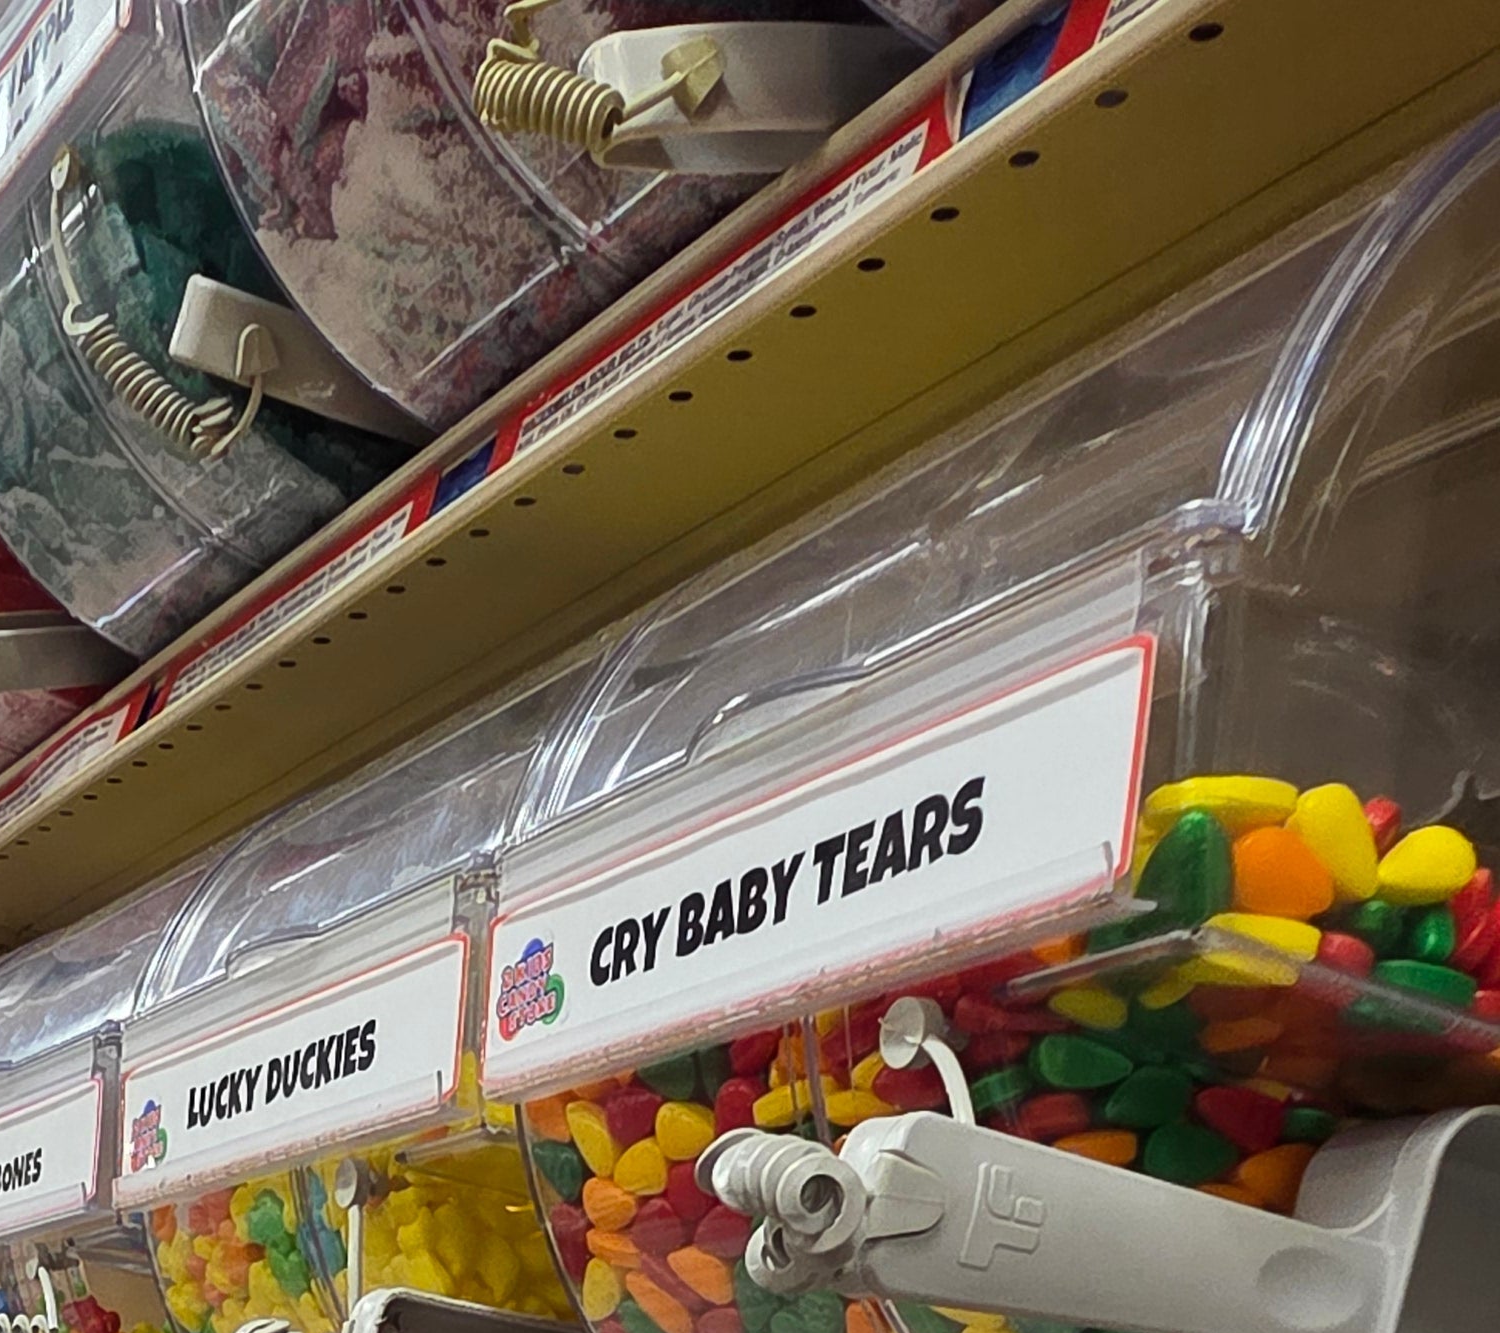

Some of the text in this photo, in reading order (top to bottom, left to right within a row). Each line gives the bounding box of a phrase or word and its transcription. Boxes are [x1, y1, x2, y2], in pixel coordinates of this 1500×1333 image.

[591, 778, 984, 985] CRY BABY TEARS
[187, 1020, 375, 1128] LUCKY DUCKIES
